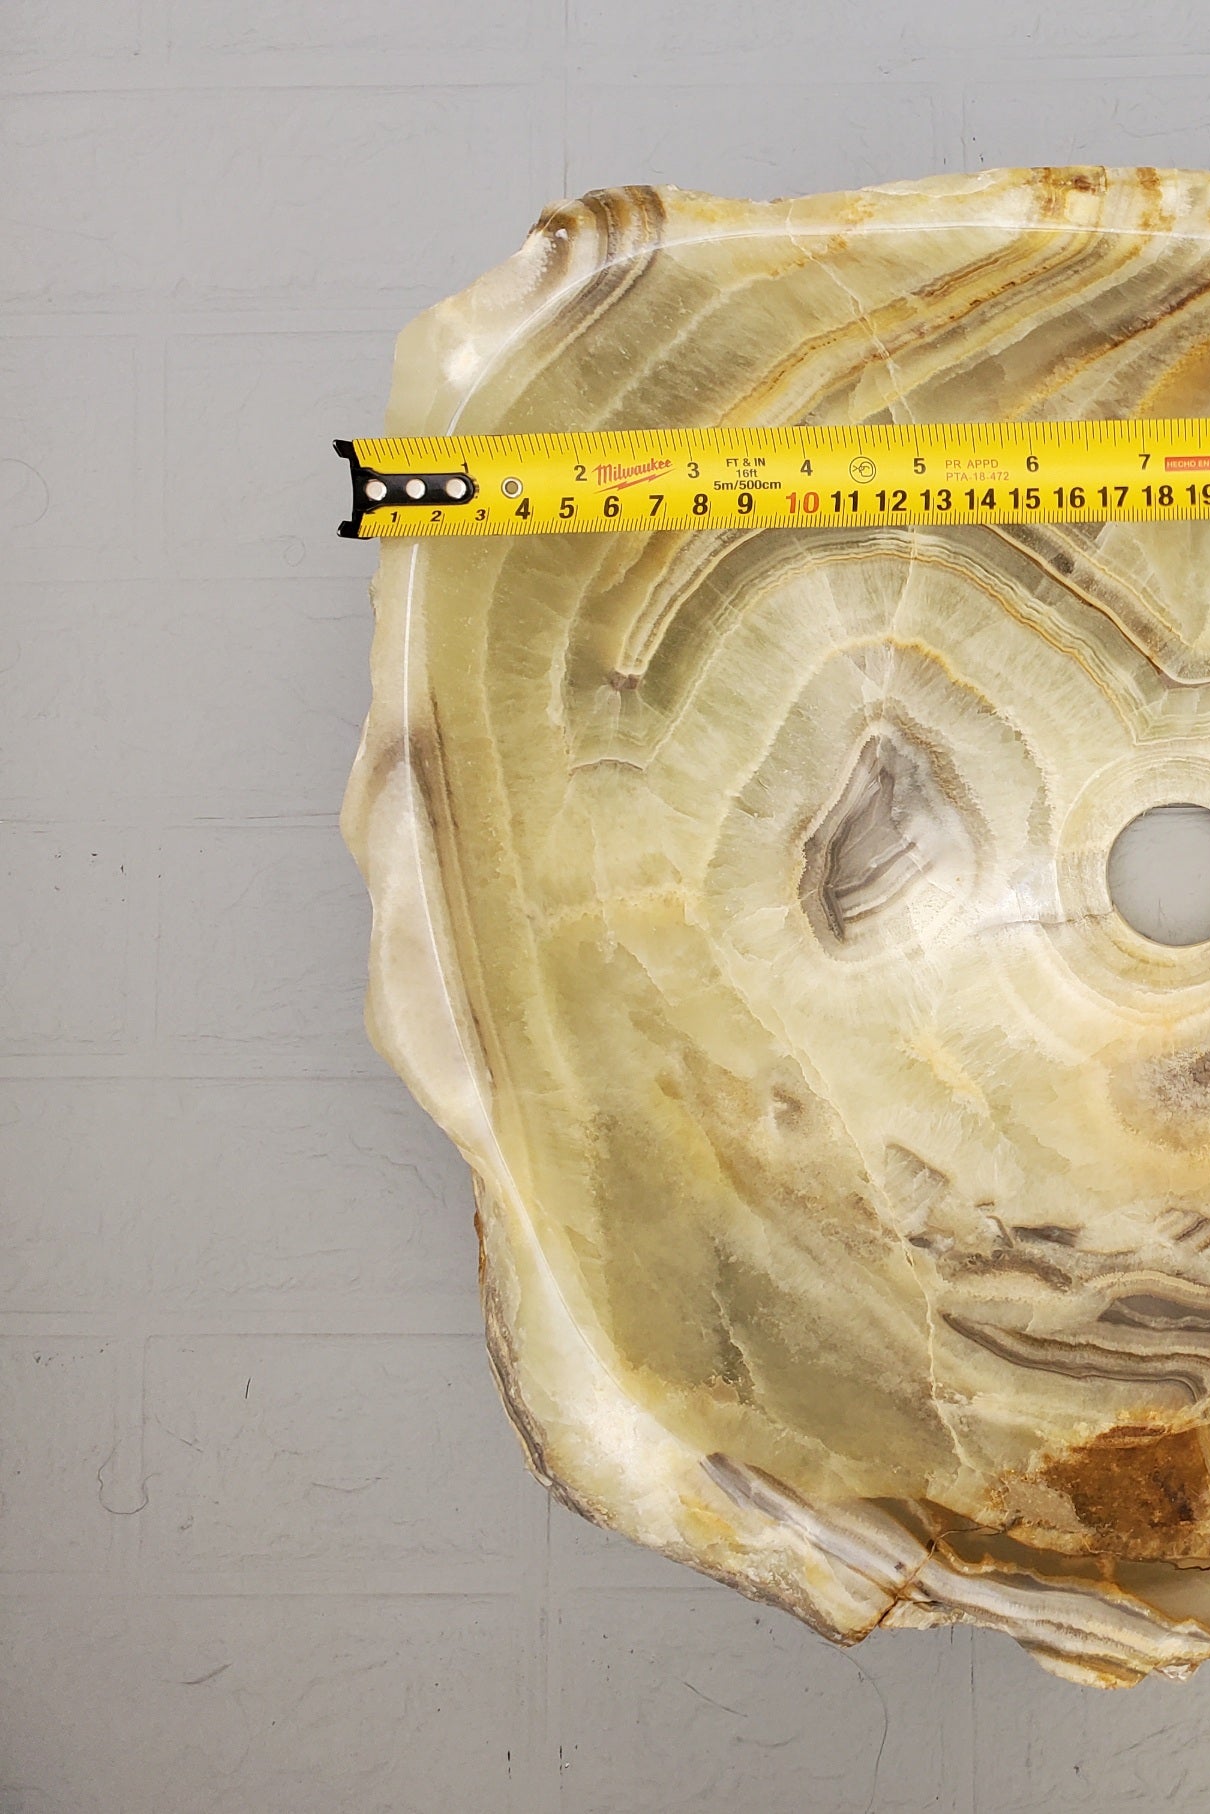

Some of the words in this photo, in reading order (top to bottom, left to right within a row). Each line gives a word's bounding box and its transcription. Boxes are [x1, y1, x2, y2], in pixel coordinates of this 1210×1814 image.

[574, 465, 587, 481] 2
[687, 462, 700, 479] 3
[800, 459, 813, 476] 4
[913, 457, 926, 475] 5
[1026, 455, 1039, 473] 6
[1138, 453, 1150, 471] 7
[726, 458, 739, 467] FT
[743, 458, 751, 467] &
[754, 457, 766, 467] IN
[945, 459, 961, 469] PR
[967, 459, 999, 469] APPD
[1166, 460, 1197, 468] HECHO
[1198, 460, 1210, 468] EN
[592, 458, 674, 486] Milwaukee
[736, 468, 758, 478] 16ft
[713, 479, 782, 491] 5m/500cm
[390, 511, 398, 522] 1
[430, 510, 442, 522] 2
[475, 509, 486, 521] 3
[515, 497, 530, 519] 4
[559, 497, 575, 519] 5
[603, 495, 619, 518] 6
[649, 495, 664, 517] 7
[692, 493, 709, 515] 8
[737, 492, 753, 514] 9
[785, 491, 820, 514] 10
[831, 491, 859, 513] 11
[875, 490, 908, 512] 12
[920, 489, 952, 511] 13
[964, 488, 996, 510] 14
[1009, 488, 1041, 510] 15
[1053, 486, 1085, 509] 16
[1097, 486, 1129, 508] 17
[1142, 485, 1174, 507] 18
